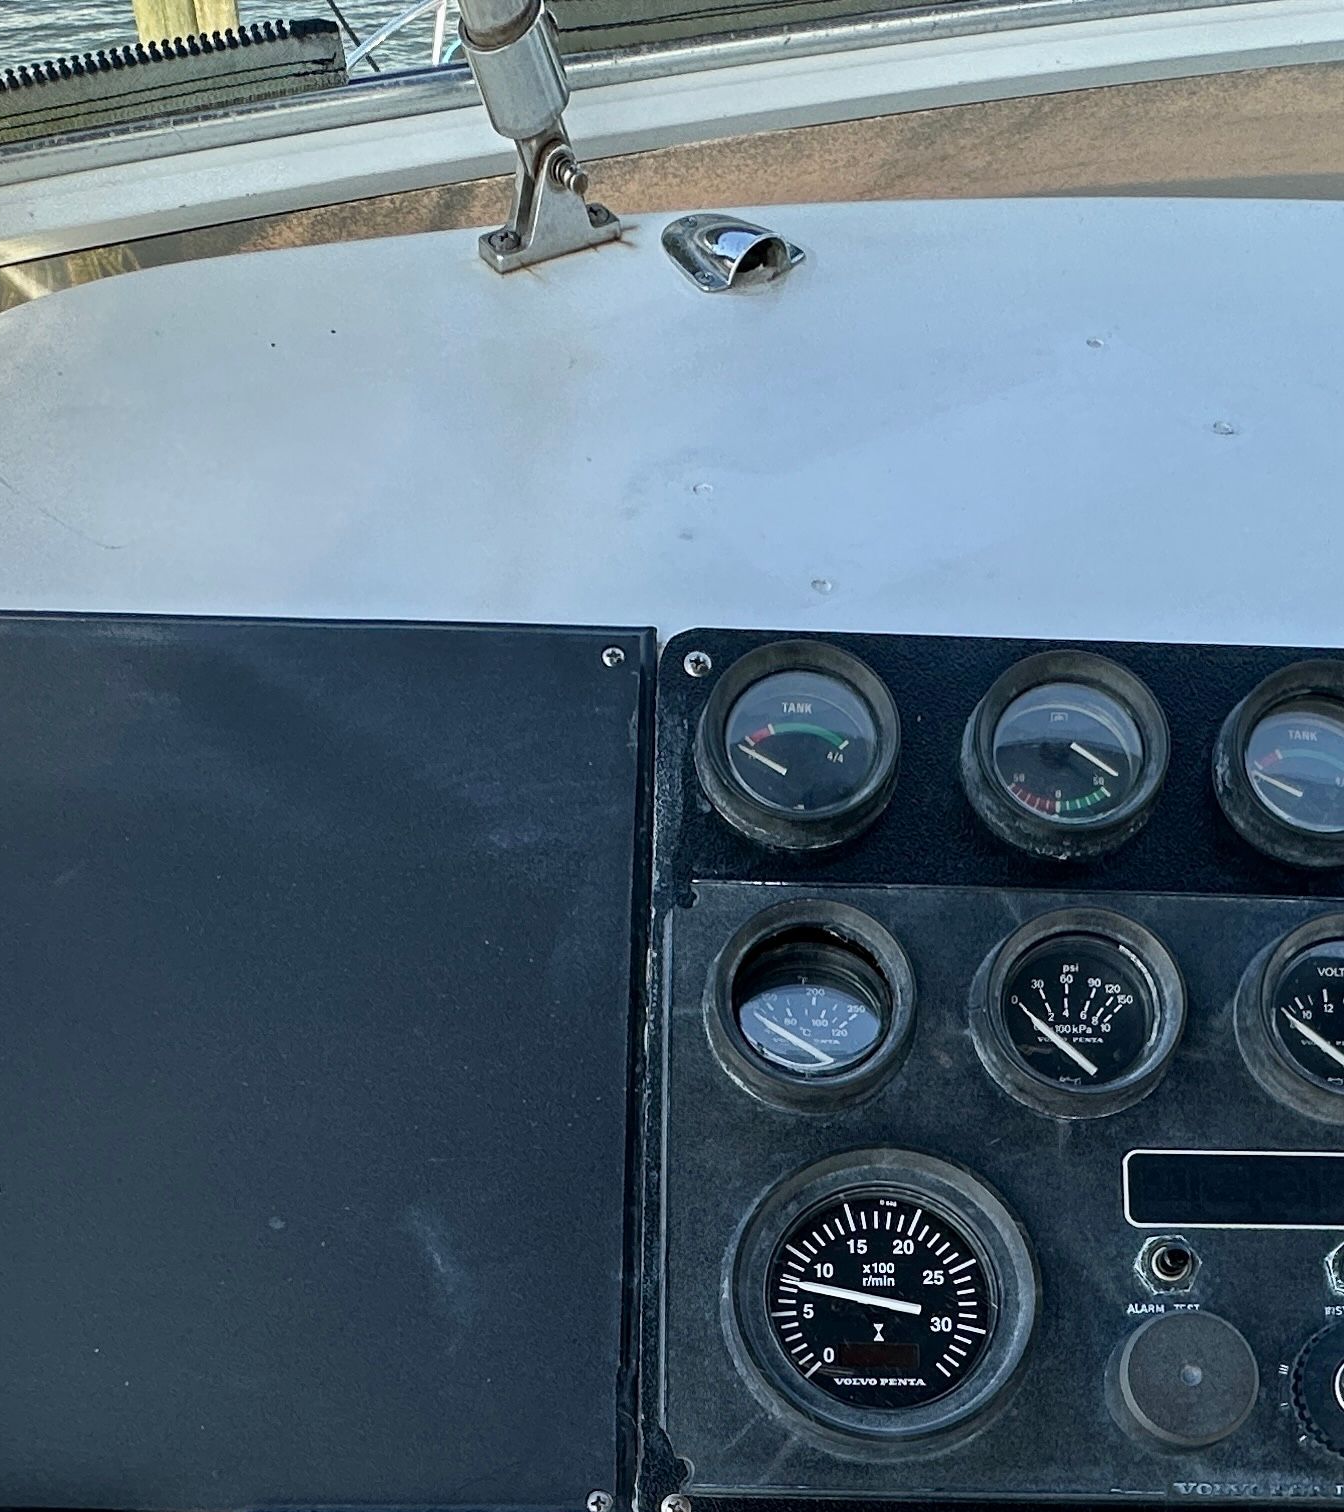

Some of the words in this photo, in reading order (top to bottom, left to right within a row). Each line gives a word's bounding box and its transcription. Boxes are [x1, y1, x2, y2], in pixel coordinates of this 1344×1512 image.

[782, 702, 812, 714] TANK
[1288, 730, 1318, 741] TANK
[826, 751, 844, 763] 4/4
[1062, 963, 1079, 973] psi
[1031, 979, 1044, 989] 30
[1060, 974, 1073, 984] 60
[1088, 978, 1101, 988] 90
[806, 988, 825, 996] 200
[1105, 984, 1121, 994] 120
[1011, 995, 1019, 1005] 0
[1117, 995, 1133, 1004] 150
[1062, 1009, 1069, 1018] 4
[1323, 1004, 1334, 1013] 12
[1048, 1013, 1055, 1021] 2
[1080, 1011, 1087, 1020] 6
[1302, 1011, 1312, 1020] 10
[1091, 1016, 1099, 1026] 8
[1072, 1024, 1093, 1034] kPa
[1100, 1023, 1111, 1033] 10
[846, 1239, 868, 1255] 15
[892, 1239, 915, 1255] 20
[813, 1263, 834, 1278] 10
[862, 1262, 895, 1274] x100
[862, 1275, 895, 1287] r/min
[922, 1270, 944, 1285] 25
[803, 1303, 814, 1319] 5
[1127, 1303, 1165, 1314] ALARM
[930, 1316, 952, 1332] 30
[823, 1347, 835, 1363] 0
[834, 1378, 878, 1386] VOLVO
[880, 1378, 926, 1386] PENTA
